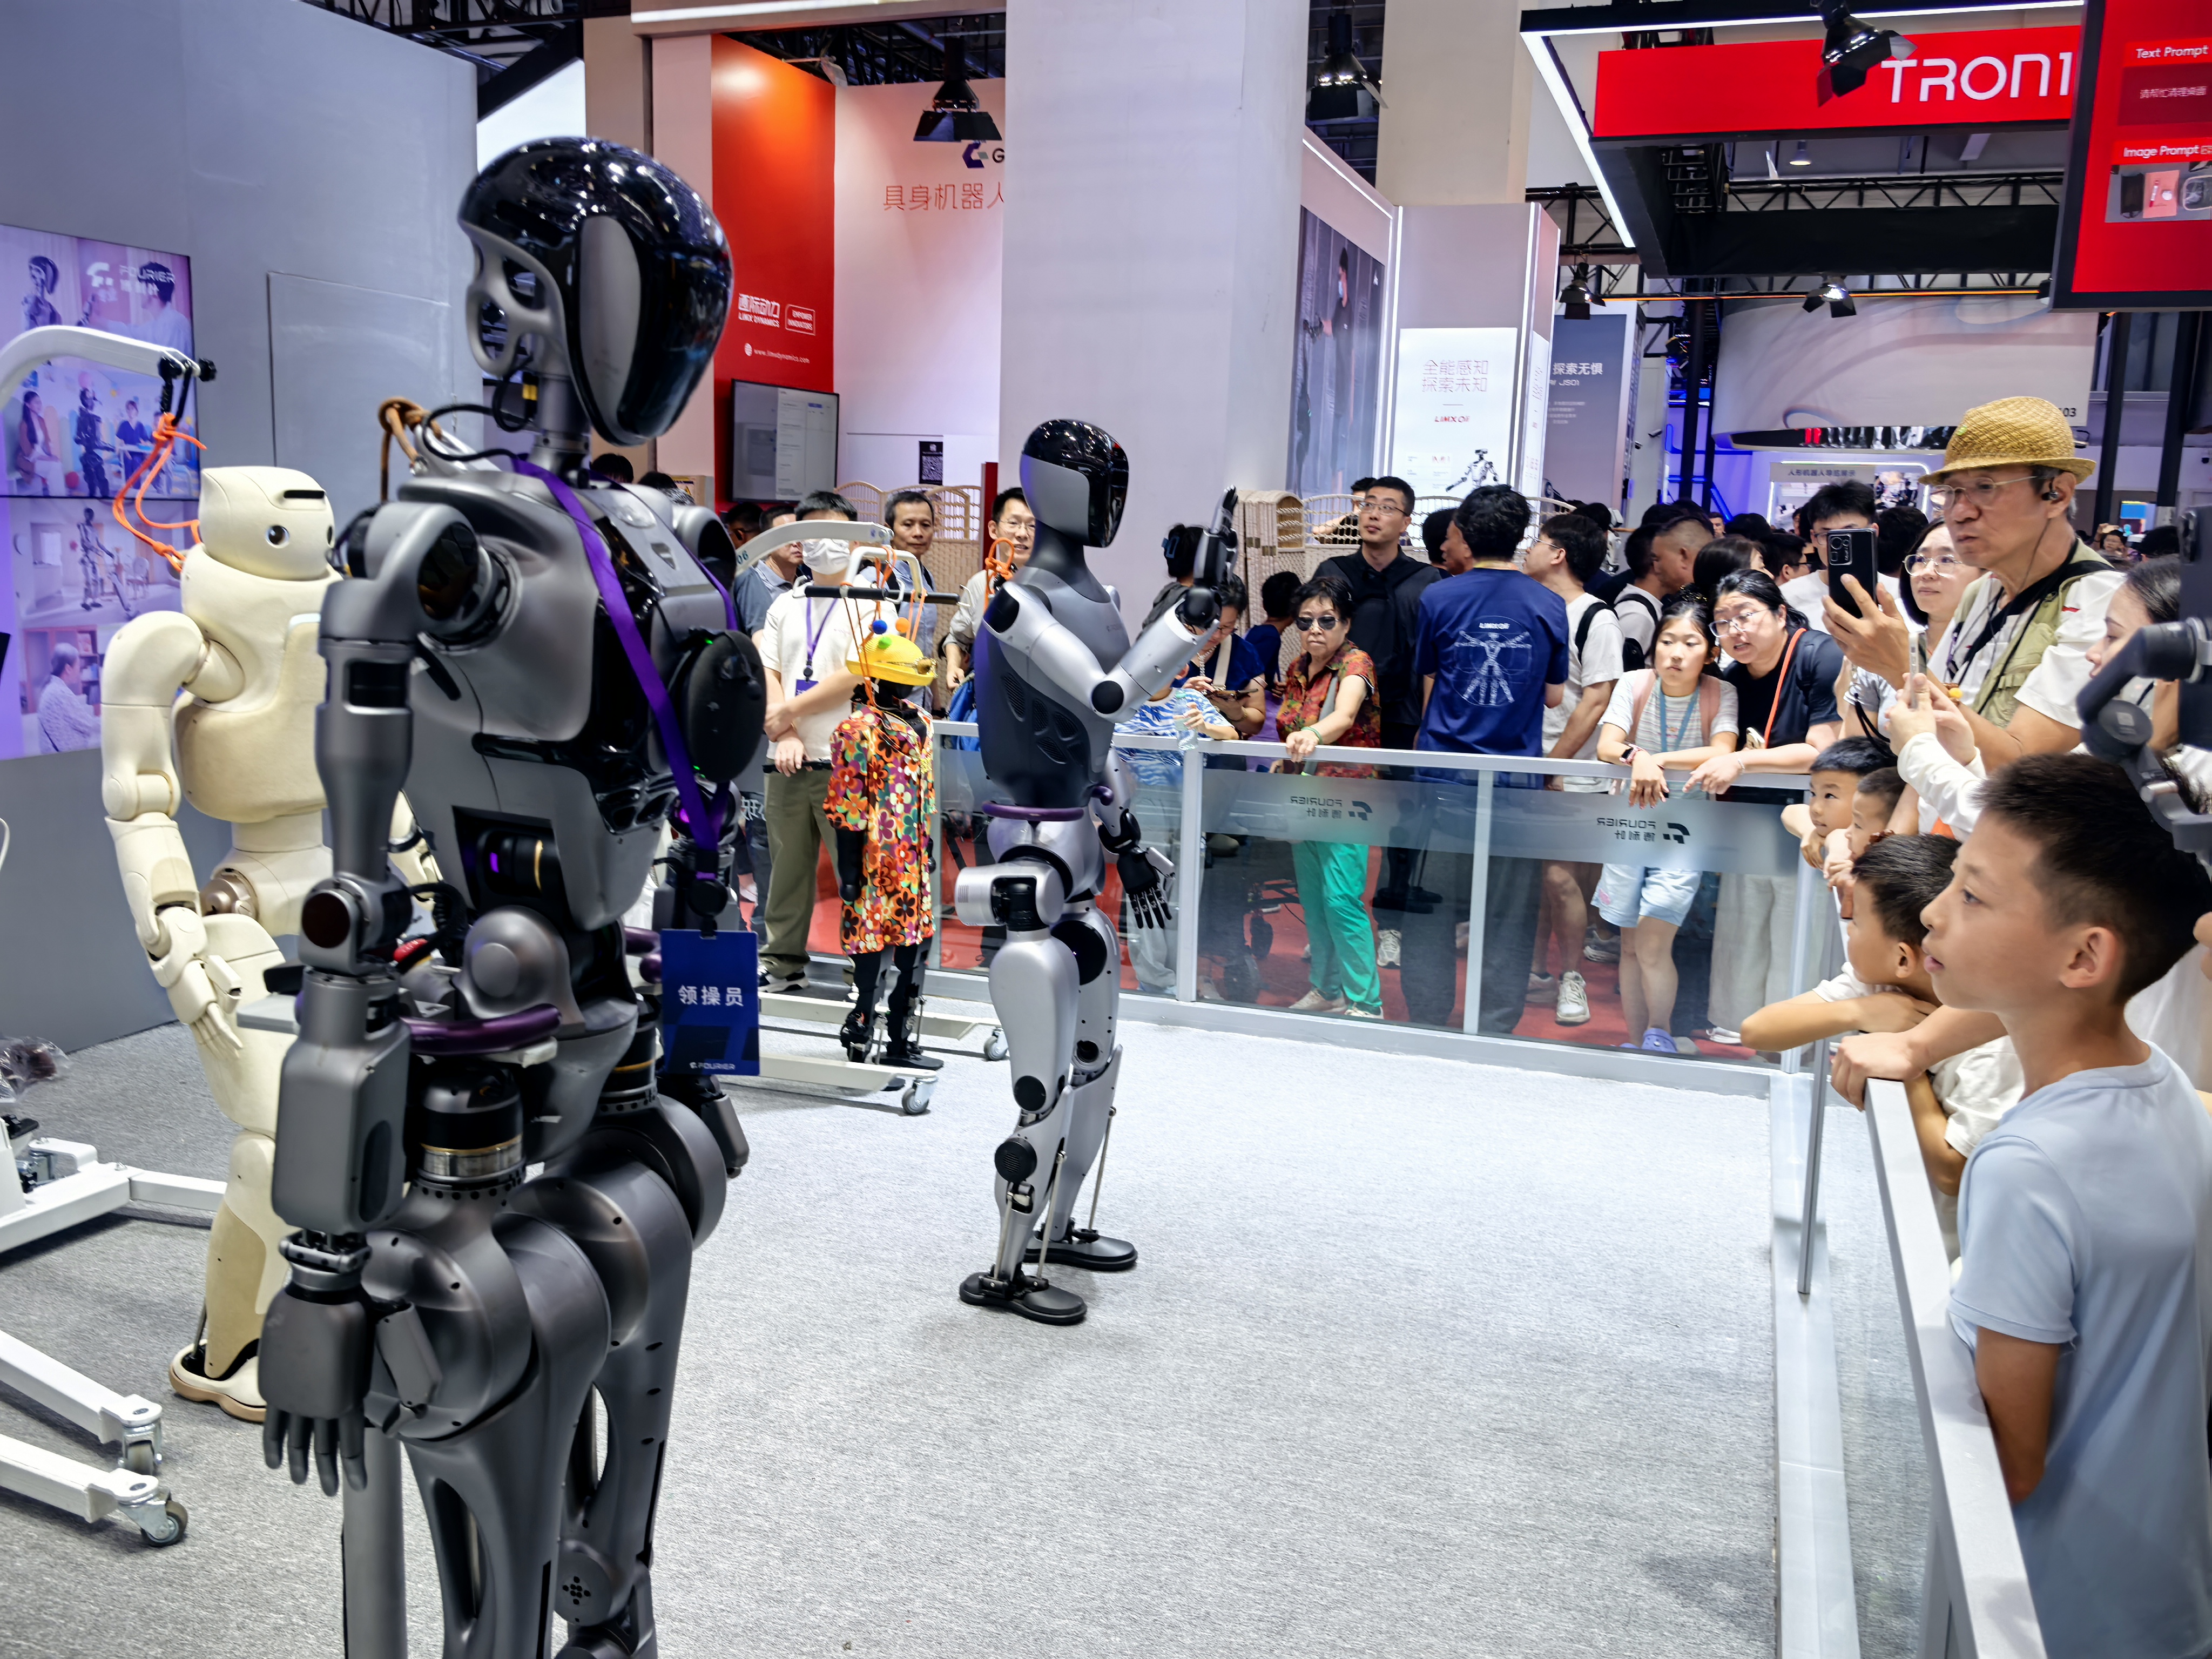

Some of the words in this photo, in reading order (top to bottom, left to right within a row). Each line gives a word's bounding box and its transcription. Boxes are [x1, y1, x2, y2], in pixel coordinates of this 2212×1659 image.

[2136, 48, 2161, 59] Text
[2163, 45, 2209, 58] Prompt
[2123, 147, 2158, 159] Image
[2159, 145, 2200, 157] Prompt
[883, 181, 1005, 211] 具身机器人
[119, 265, 175, 284] FOURIER
[1422, 360, 1489, 375] 全能感知
[1553, 362, 1603, 375] 探索无惧
[1422, 377, 1488, 392] 探索未知
[2059, 407, 2076, 417] 03
[678, 984, 744, 1007] 领操员
[698, 1062, 736, 1070] FOURIER
